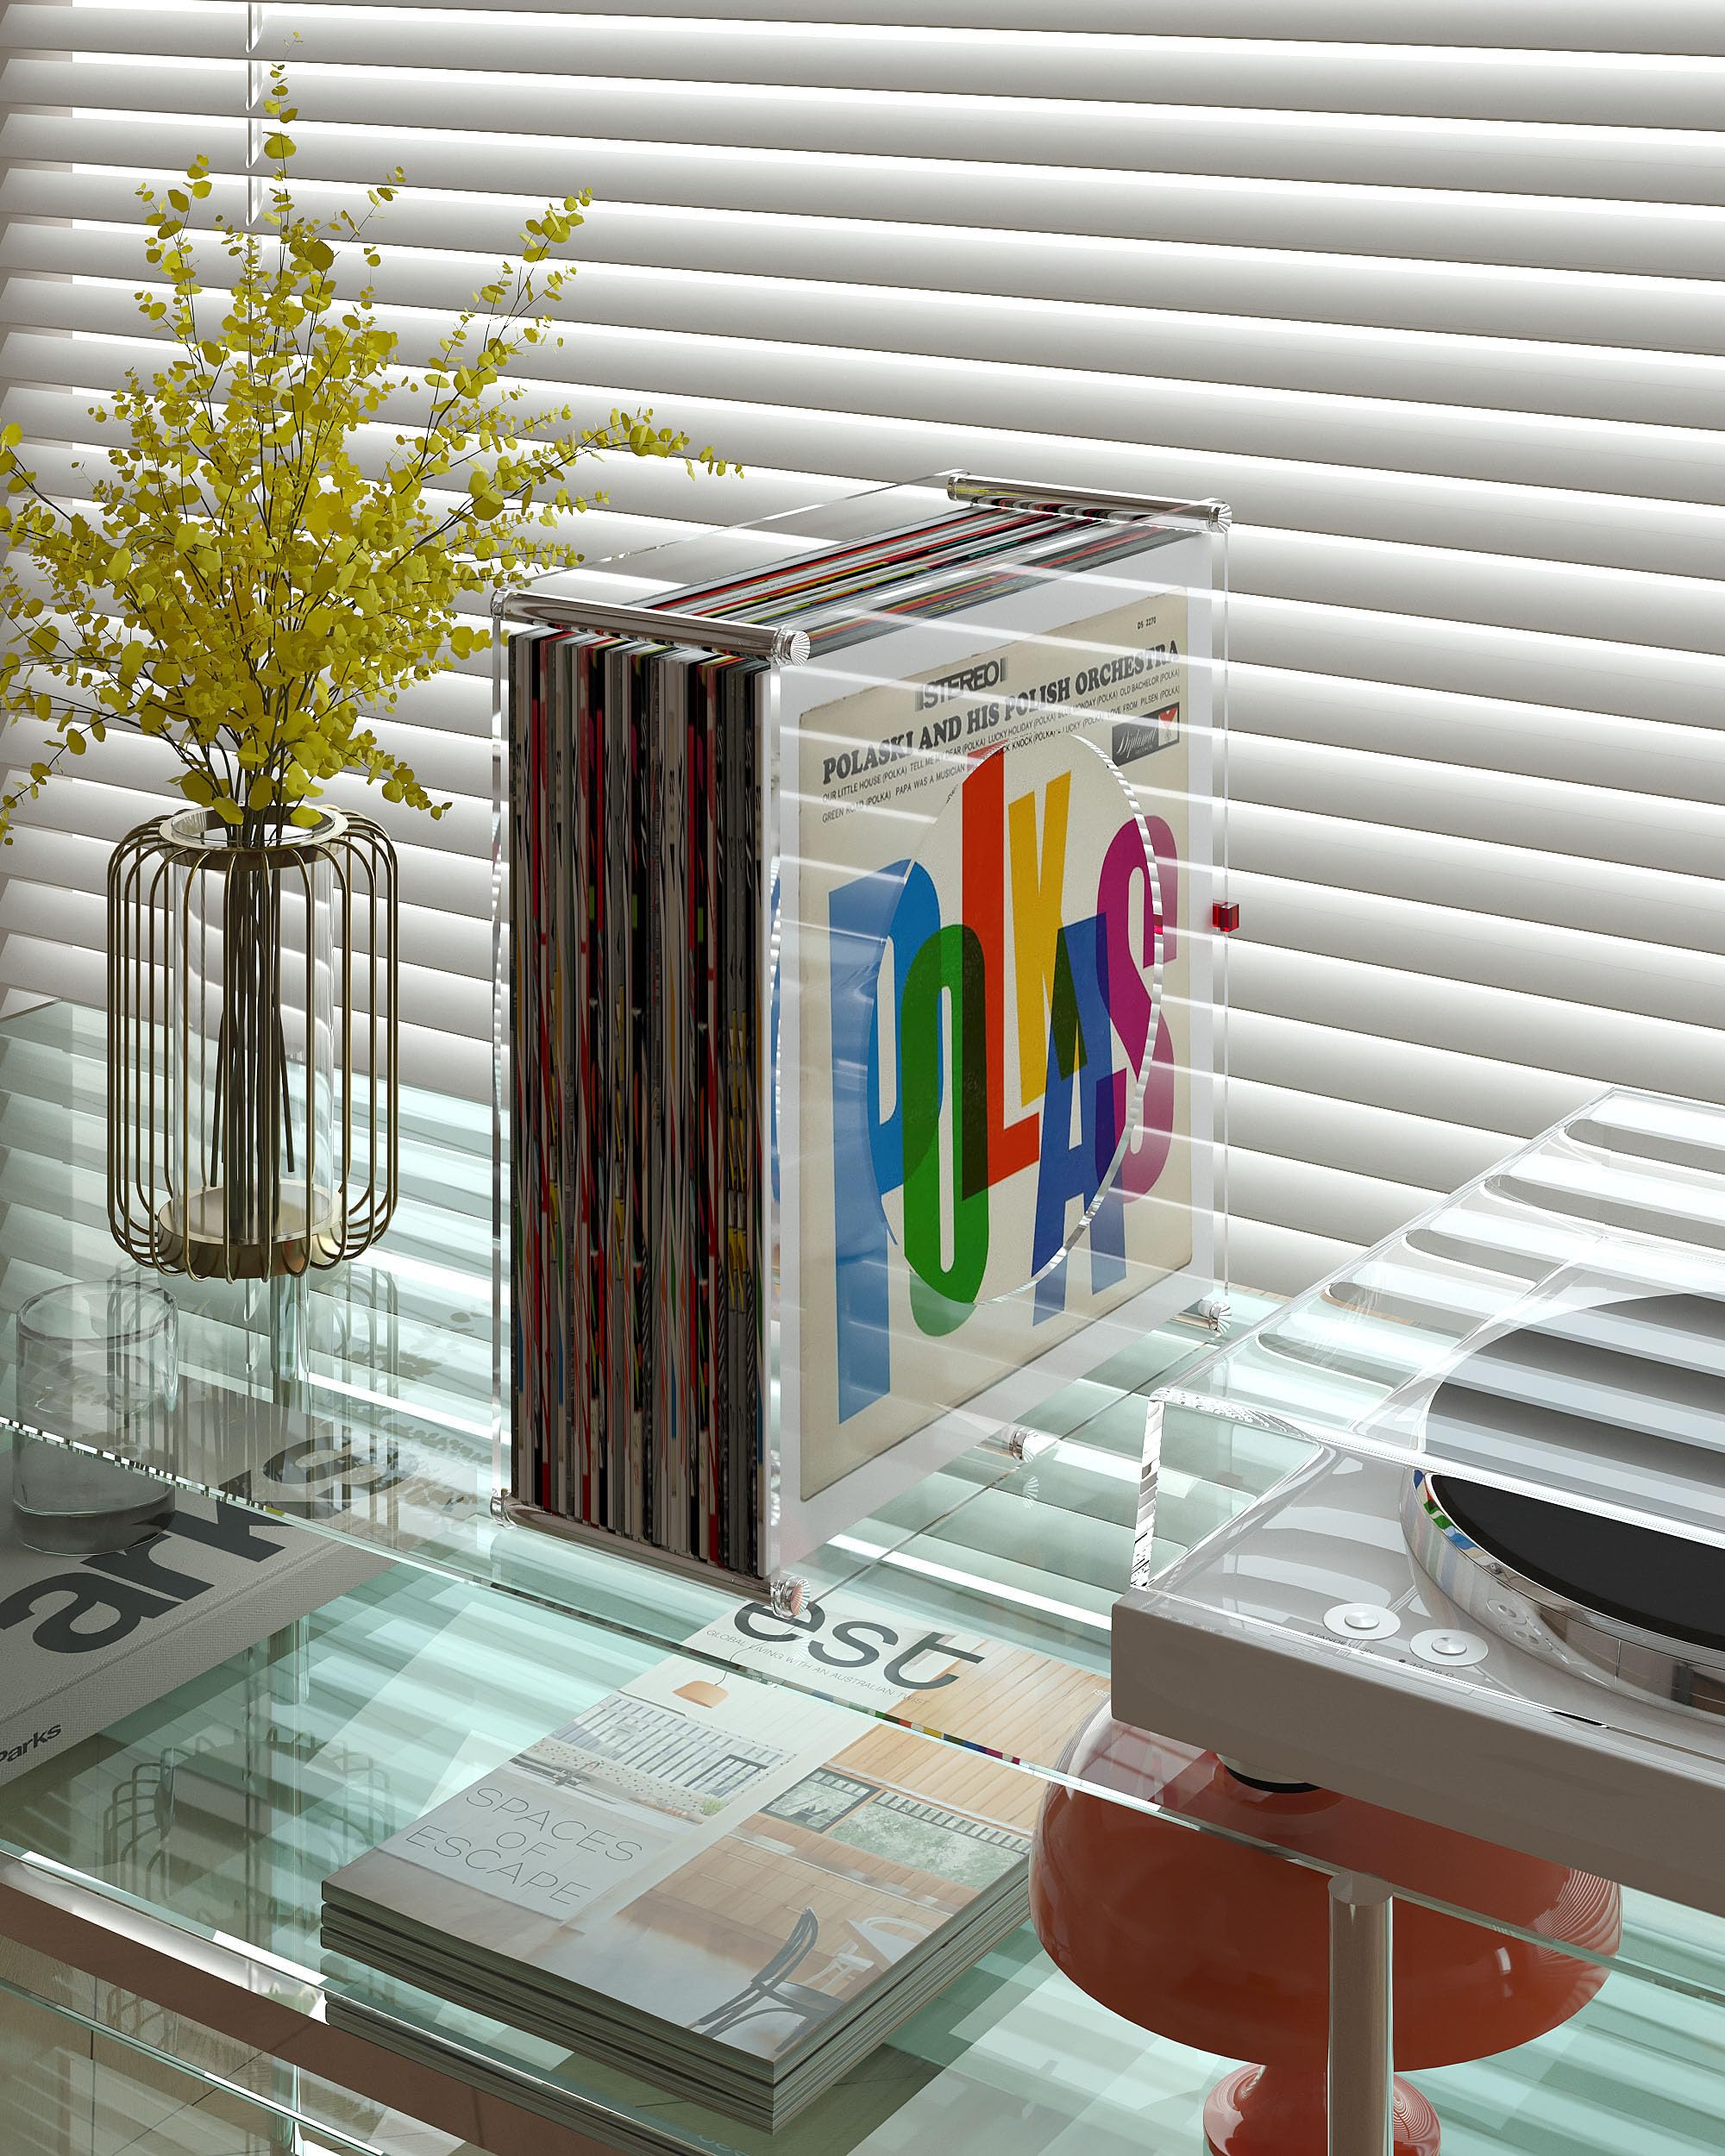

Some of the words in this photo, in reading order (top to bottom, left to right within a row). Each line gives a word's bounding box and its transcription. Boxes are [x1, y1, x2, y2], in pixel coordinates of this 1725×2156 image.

[823, 731, 913, 785] POLASKI
[919, 715, 962, 751] AND
[967, 703, 1000, 735] HIS
[1004, 676, 1070, 721] POLISH
[1075, 640, 1179, 695] ORCHESTRA
[922, 661, 1000, 709] STEREO
[822, 789, 837, 803] OUR
[837, 783, 857, 799] LITTLE
[859, 777, 881, 790] HOUSE
[882, 768, 907, 784] (POLKA)
[910, 761, 924, 773] TELL
[925, 757, 933, 768] ME
[962, 738, 986, 754] (POLKA)
[988, 730, 1007, 743] LUCKY
[1008, 721, 1033, 736] HOLIDAY
[1033, 714, 1056, 729] (POLKA)
[1073, 697, 1096, 712] MONDAY
[1097, 691, 1119, 705] (POLKA)
[1120, 686, 1130, 697] OLD
[1132, 676, 1159, 693] BACHELOR
[1160, 668, 1180, 684] (POLKA)
[822, 807, 844, 823] GREEN
[866, 790, 891, 806] (POLKA)
[895, 784, 912, 796] PAPA
[913, 777, 927, 789] WAS
[936, 763, 965, 781] MUSICIAN
[1012, 736, 1032, 750] KNOCK
[1032, 730, 1056, 744] (POLKA)
[1123, 700, 1138, 712] FROM
[1140, 693, 1158, 706] PILSEN
[1160, 685, 1180, 700] (POLKA)
[706, 1630, 746, 1646] GLOBAL
[750, 1644, 784, 1659] LIVING
[786, 1657, 812, 1669] WITH
[813, 1666, 830, 1676] AN
[829, 1672, 895, 1695] AUSTRALIAN
[897, 1692, 930, 1705] TWIST
[734, 1601, 985, 1690] est
[466, 1788, 643, 1861] SPACES
[496, 1832, 557, 1856] OF
[405, 1825, 592, 1905] ESCAPE
